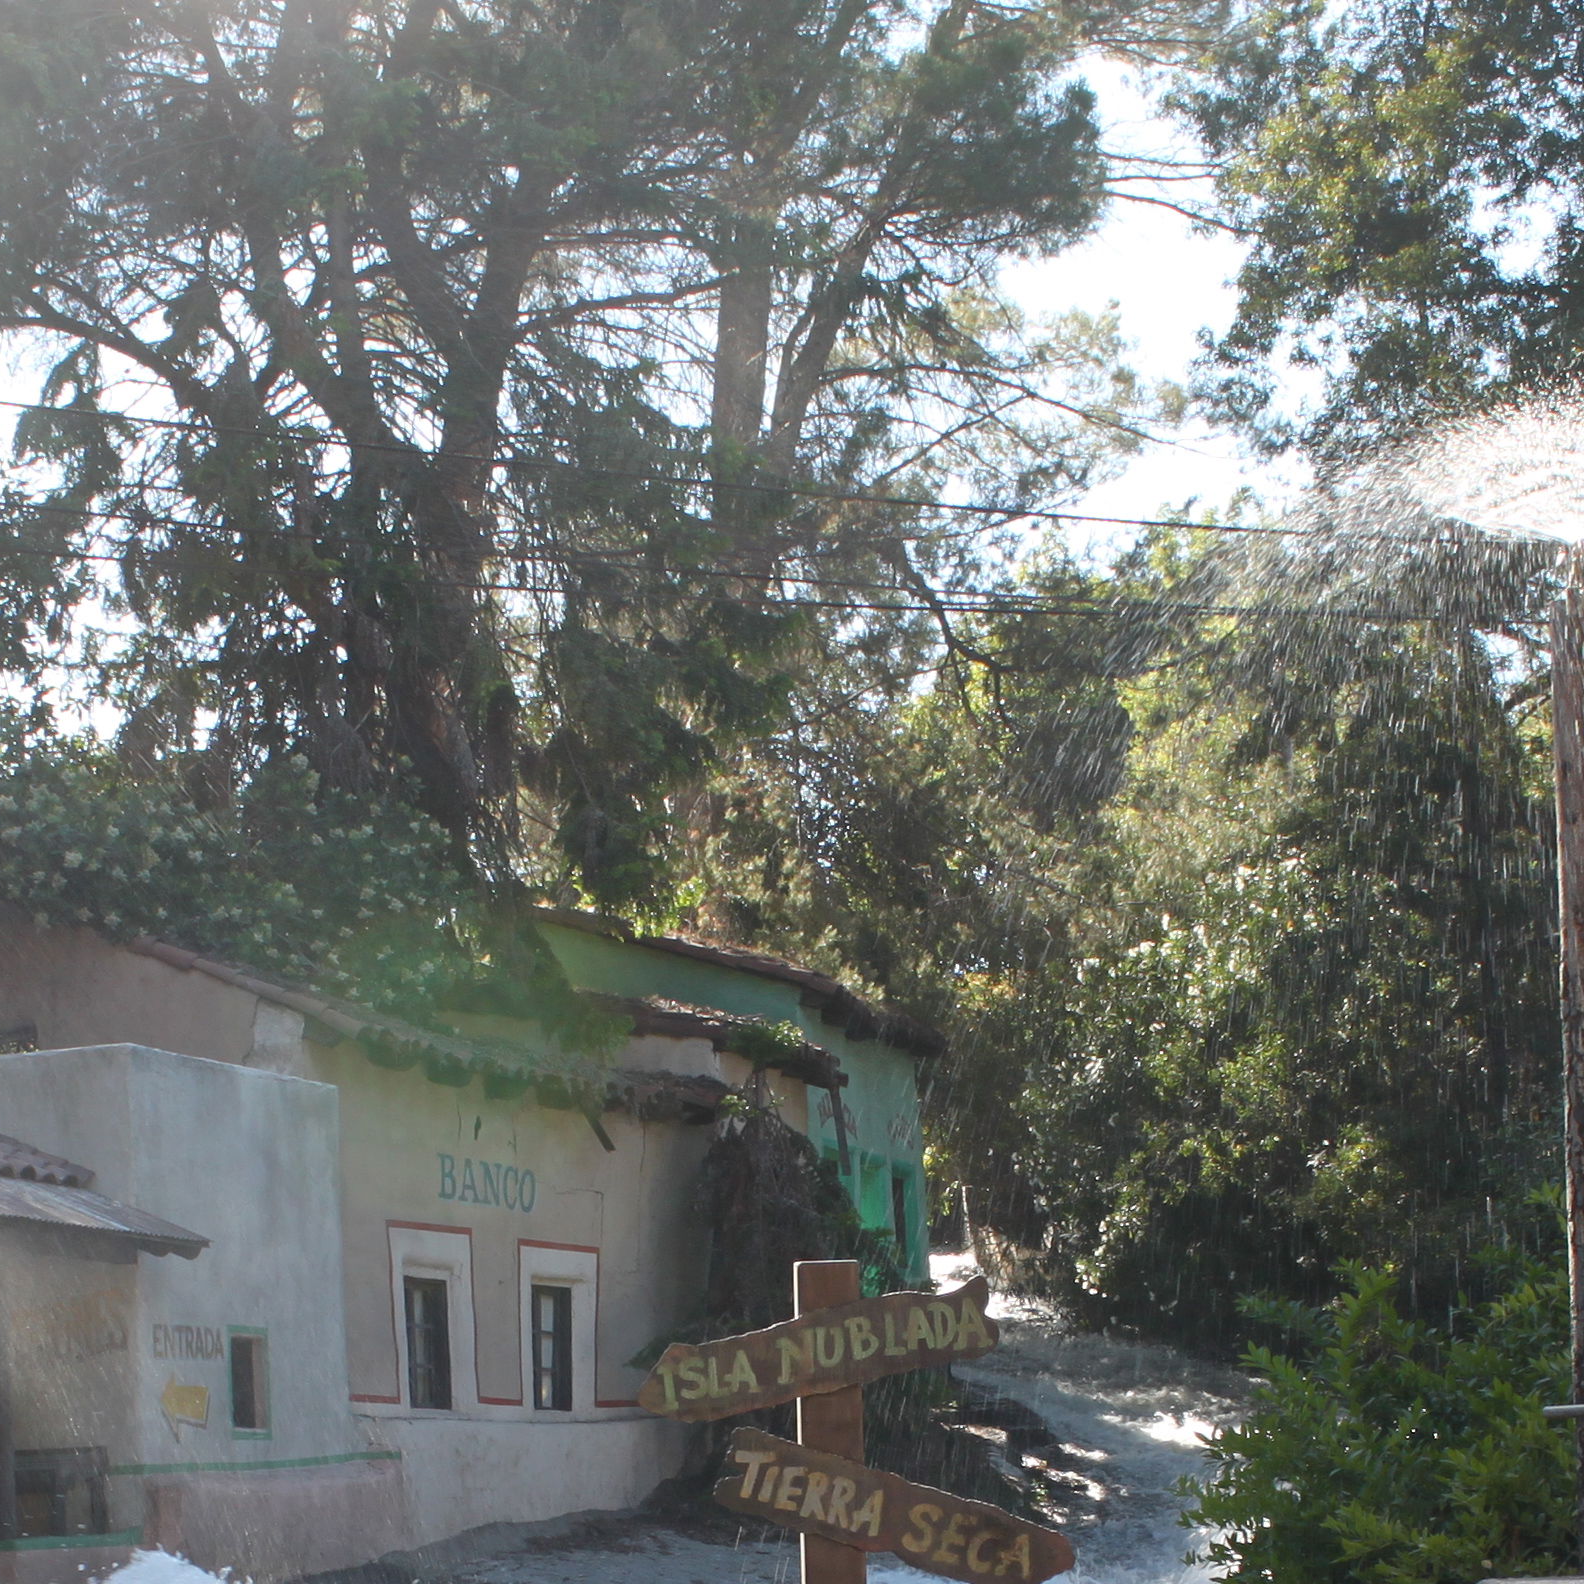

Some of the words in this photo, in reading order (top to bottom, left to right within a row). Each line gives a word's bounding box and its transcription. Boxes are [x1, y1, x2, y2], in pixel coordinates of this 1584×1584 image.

[438, 1154, 536, 1213] BANCO
[152, 1323, 225, 1361] ENTRADA
[657, 1347, 761, 1412] ISLA
[776, 1300, 993, 1384] NUBLADA
[734, 1449, 883, 1538] TIERRA
[901, 1502, 1033, 1580] SECA
